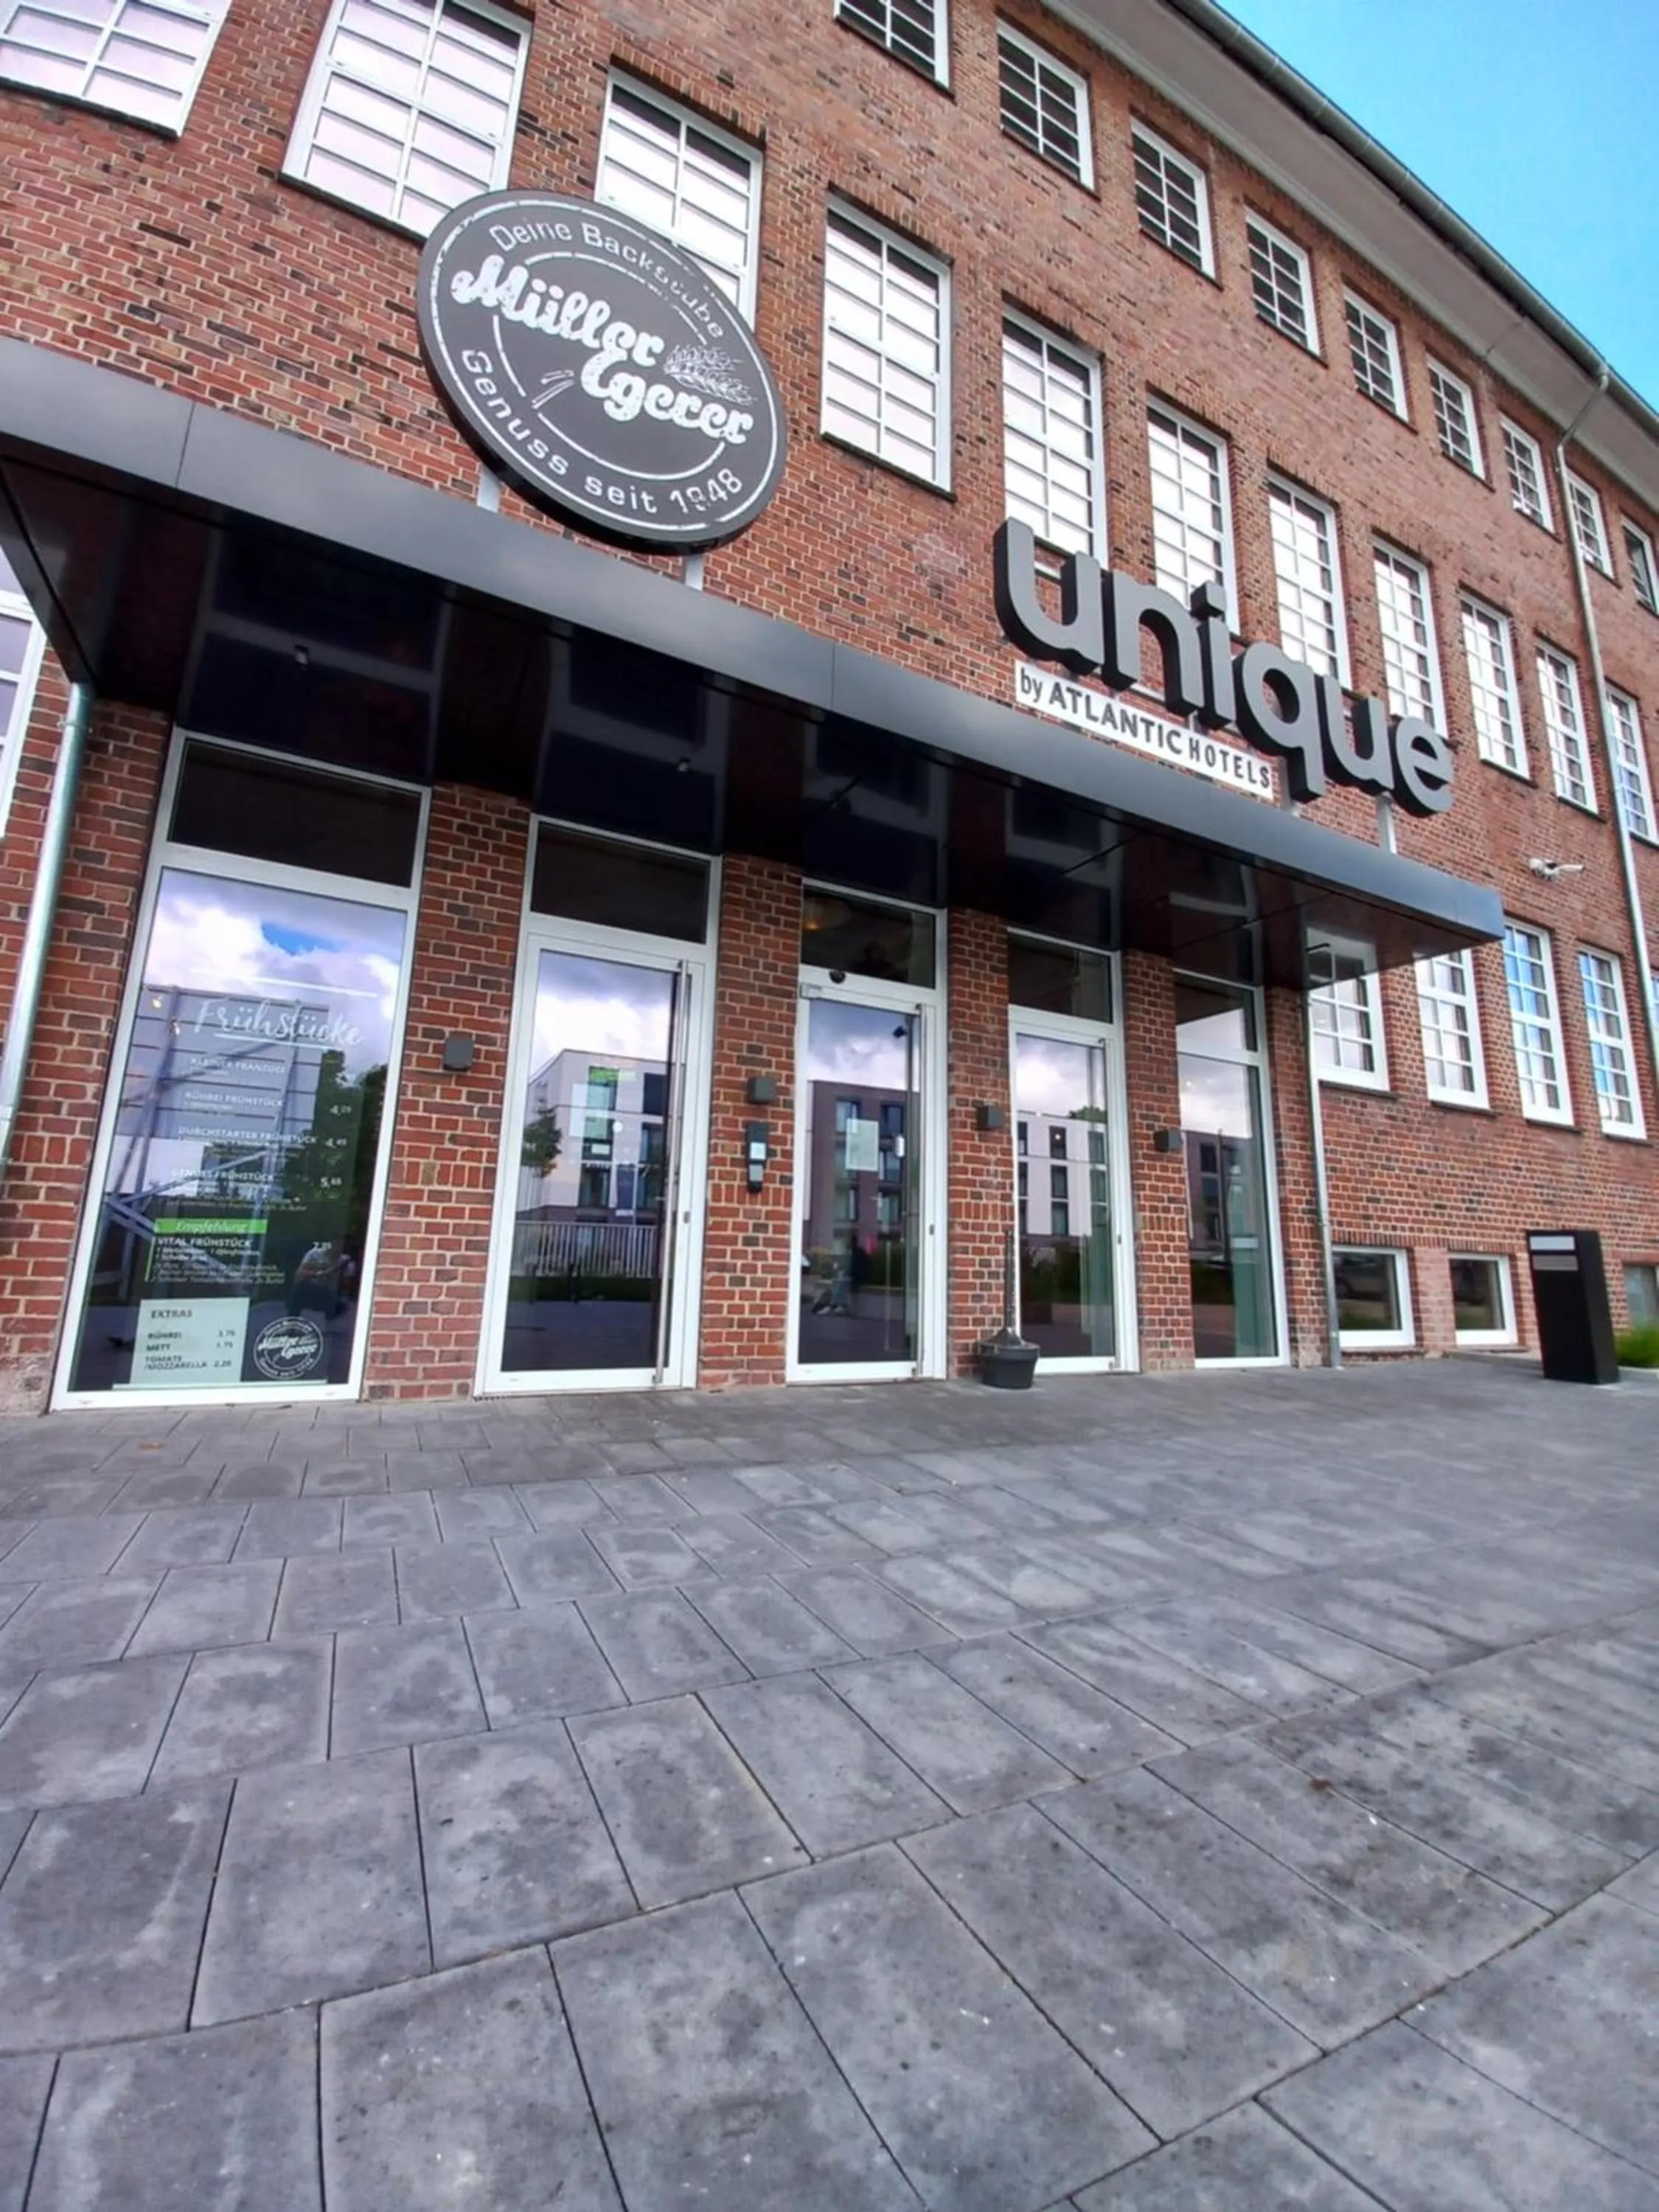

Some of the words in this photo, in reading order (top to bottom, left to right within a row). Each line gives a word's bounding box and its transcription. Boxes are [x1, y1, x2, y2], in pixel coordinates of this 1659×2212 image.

[451, 254, 664, 367] Müller
[490, 220, 572, 251] Deine
[581, 222, 723, 338] Backstube
[462, 349, 569, 476] Genuss
[585, 476, 658, 513] seit
[669, 467, 742, 514] 1948
[580, 351, 754, 445] Egerer
[995, 517, 1454, 814] unique
[1020, 667, 1043, 703] by
[1049, 681, 1183, 755] ATLANTIC
[1188, 737, 1271, 789] HOTELS
[150, 1309, 193, 1319] EXTRAS
